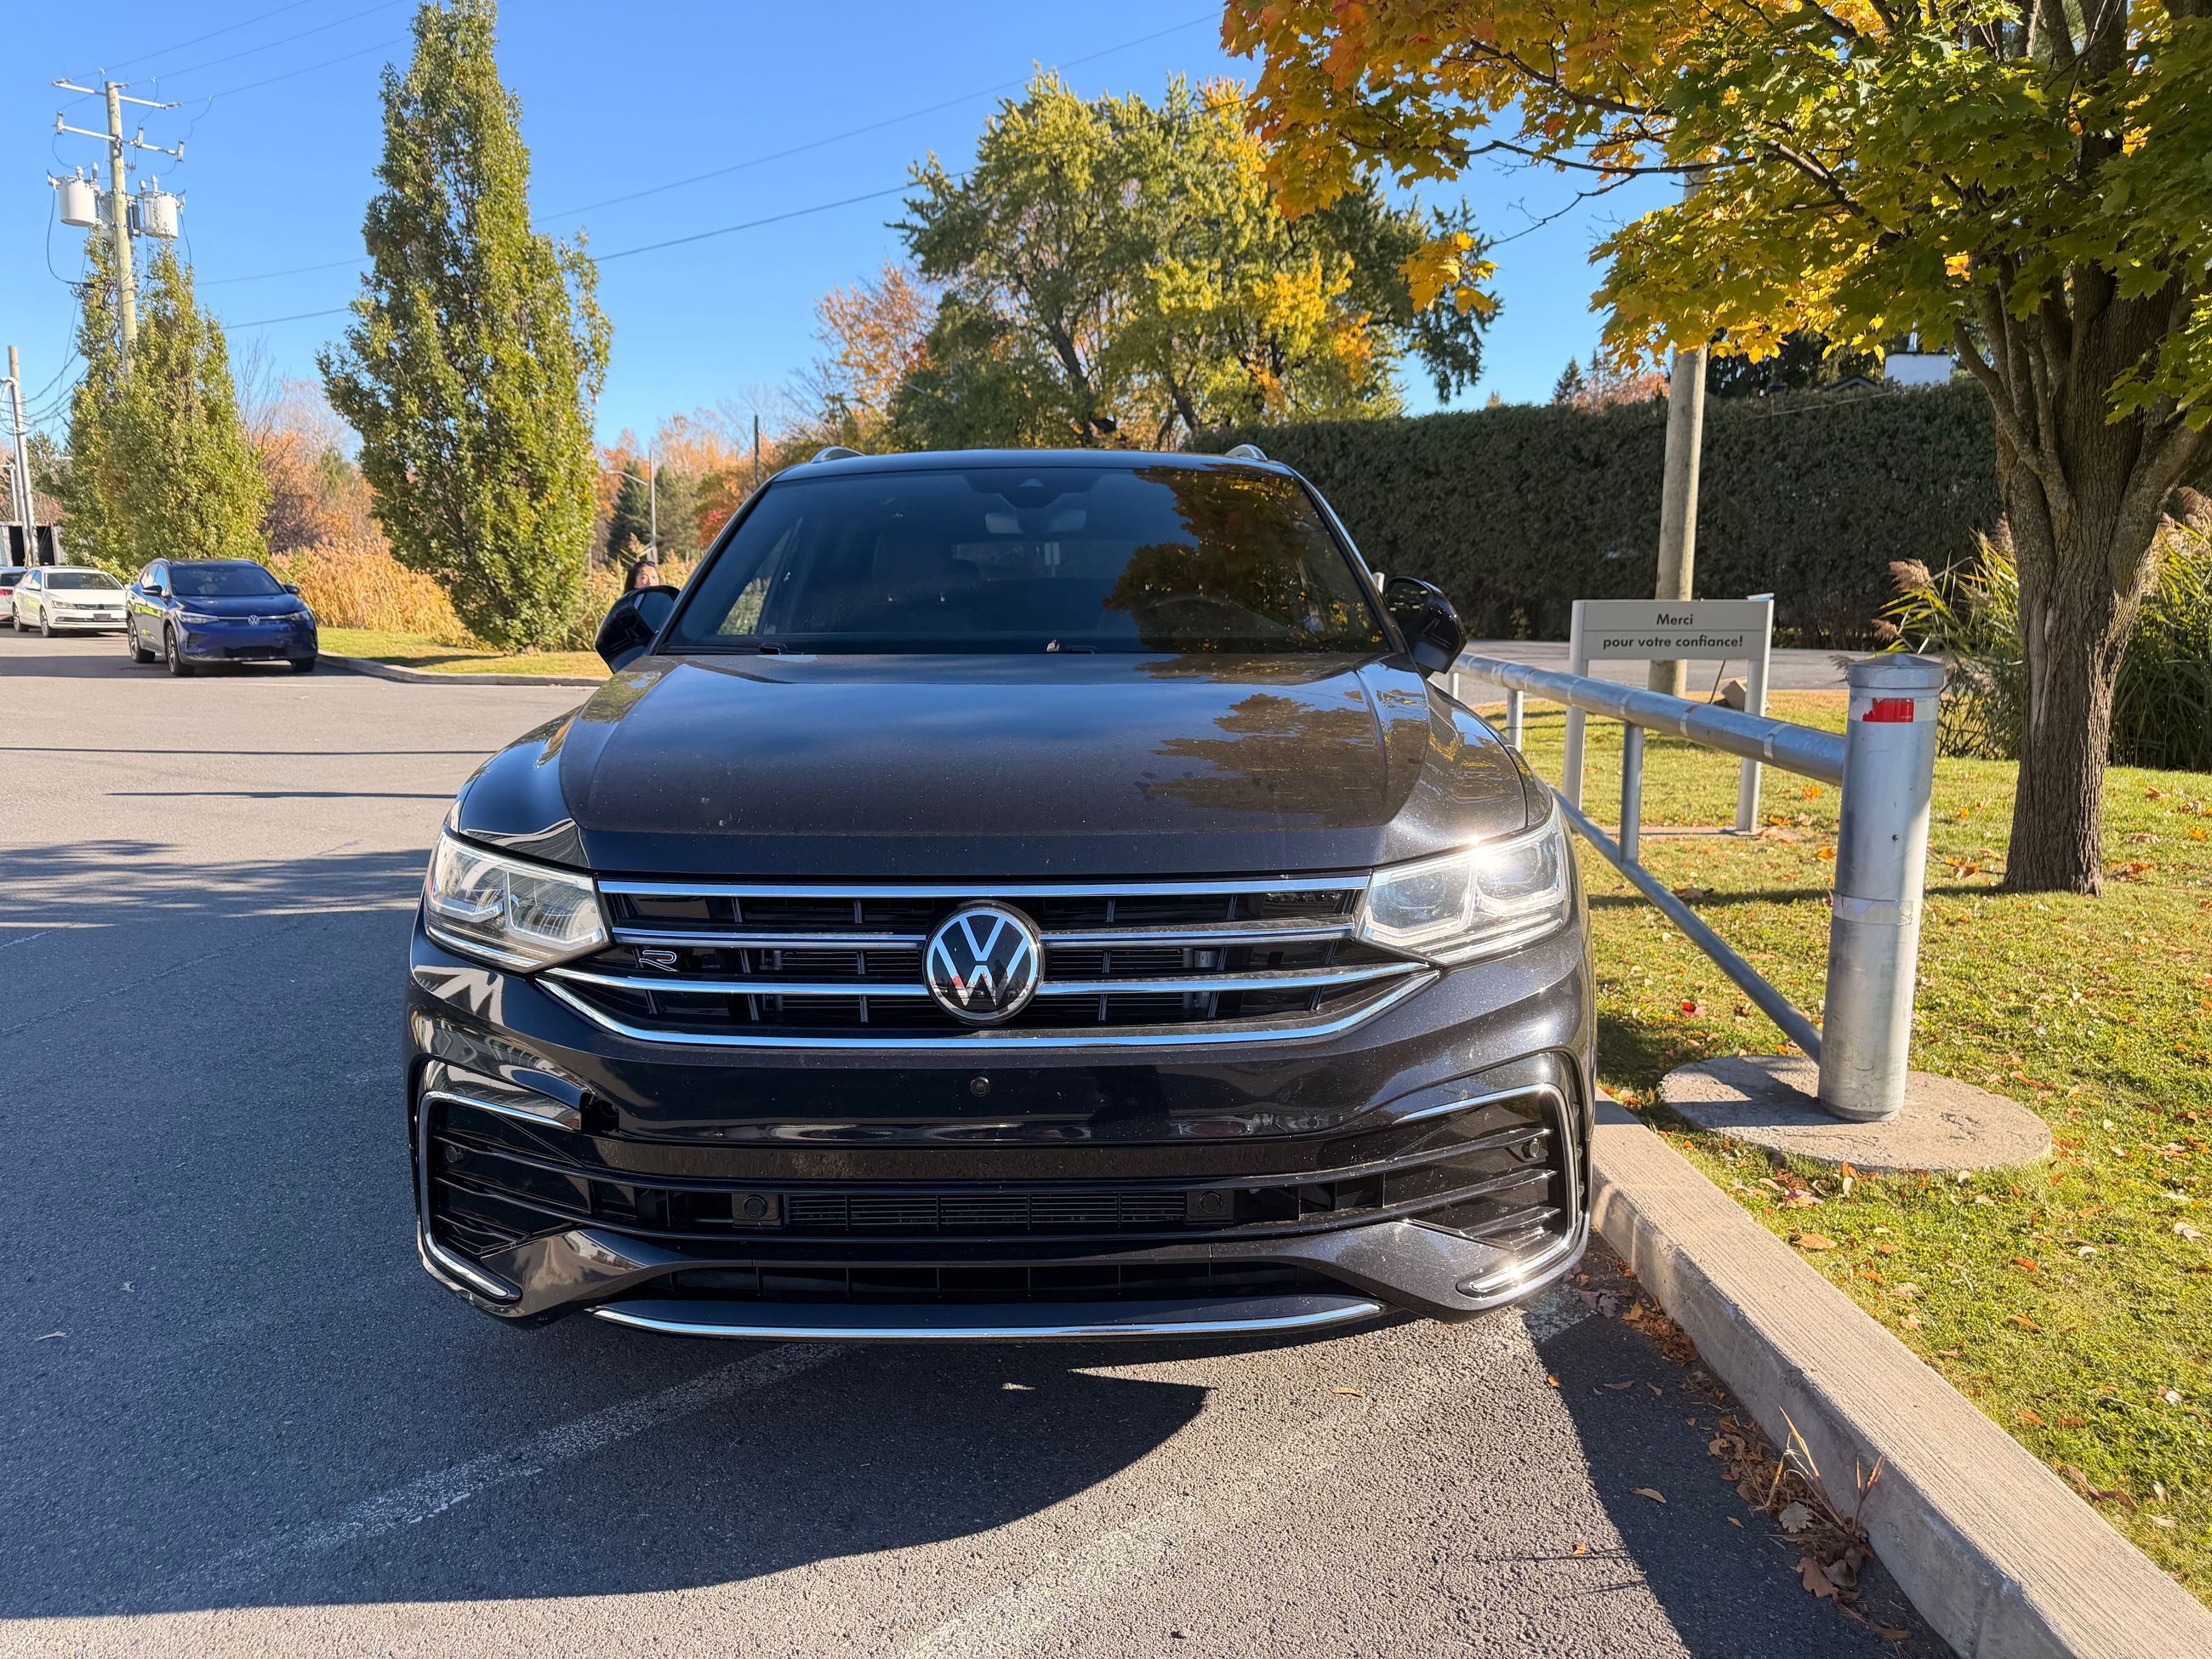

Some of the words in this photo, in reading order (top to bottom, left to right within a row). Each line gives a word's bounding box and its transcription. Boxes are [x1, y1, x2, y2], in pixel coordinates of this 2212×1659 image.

[1656, 613, 1693, 625] Merci
[1603, 637, 1633, 650] pour
[1638, 636, 1671, 647] votre
[1675, 634, 1743, 647] confiance!
[926, 909, 1038, 1020] VW
